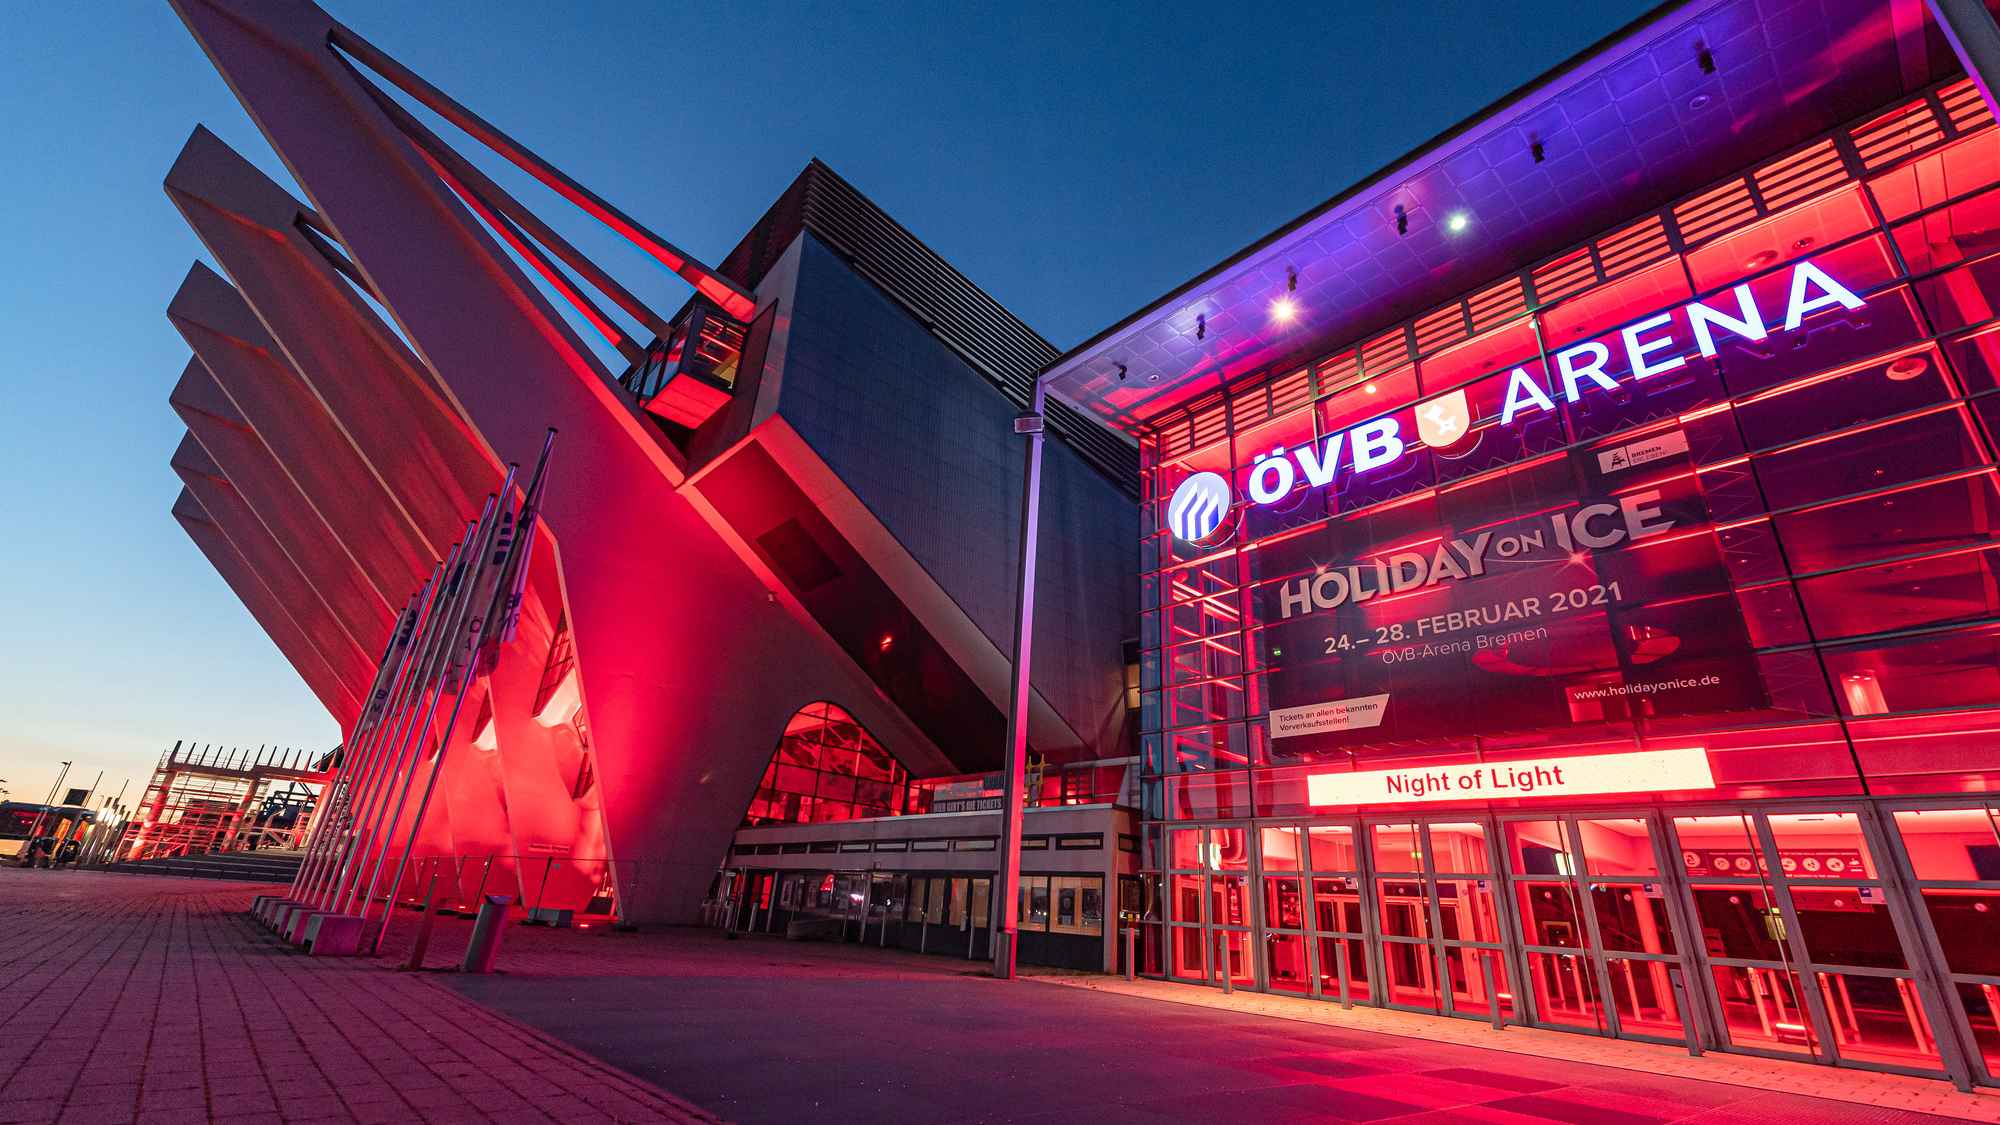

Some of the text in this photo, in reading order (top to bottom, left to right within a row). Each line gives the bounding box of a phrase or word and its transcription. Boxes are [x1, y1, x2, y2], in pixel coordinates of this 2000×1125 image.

[1249, 260, 1867, 505] ÖVB ARENA
[1631, 446, 1662, 458] BREMEN
[1280, 489, 1677, 620] HOLIDAY ON ICE
[1375, 624, 1411, 645] 28.
[1416, 597, 1541, 638] FEBRUAR
[1549, 580, 1624, 613] 2021
[1476, 626, 1548, 650] Bremen
[1574, 674, 1720, 700] www.holidayonice.de
[1280, 703, 1378, 723] Tickets an allen bekannten
[1280, 716, 1350, 731] Vorverkaufsstellen!
[1386, 765, 1565, 797] Night of Light
[977, 798, 1002, 810] TICKETS
